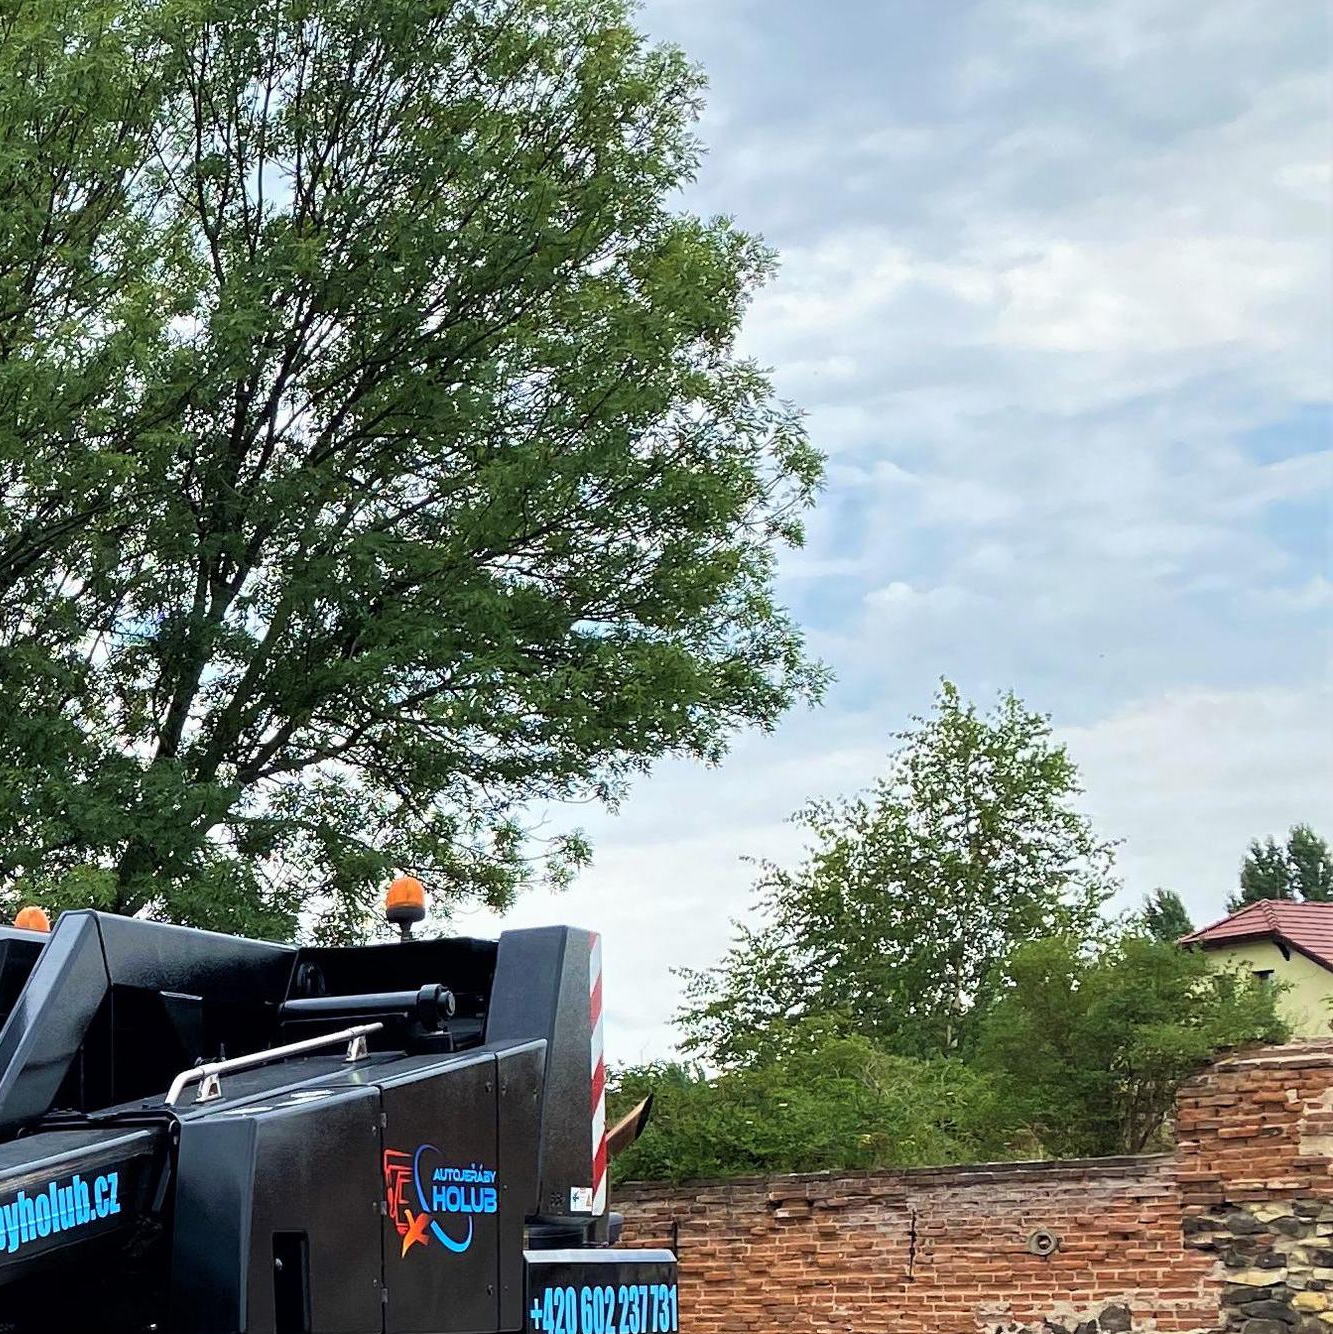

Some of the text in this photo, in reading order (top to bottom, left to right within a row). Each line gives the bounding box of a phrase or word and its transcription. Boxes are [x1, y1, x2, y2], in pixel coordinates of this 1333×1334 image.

[432, 1186, 498, 1213] HOLUB
[618, 1285, 648, 1334] 237
[650, 1284, 678, 1333] 731
